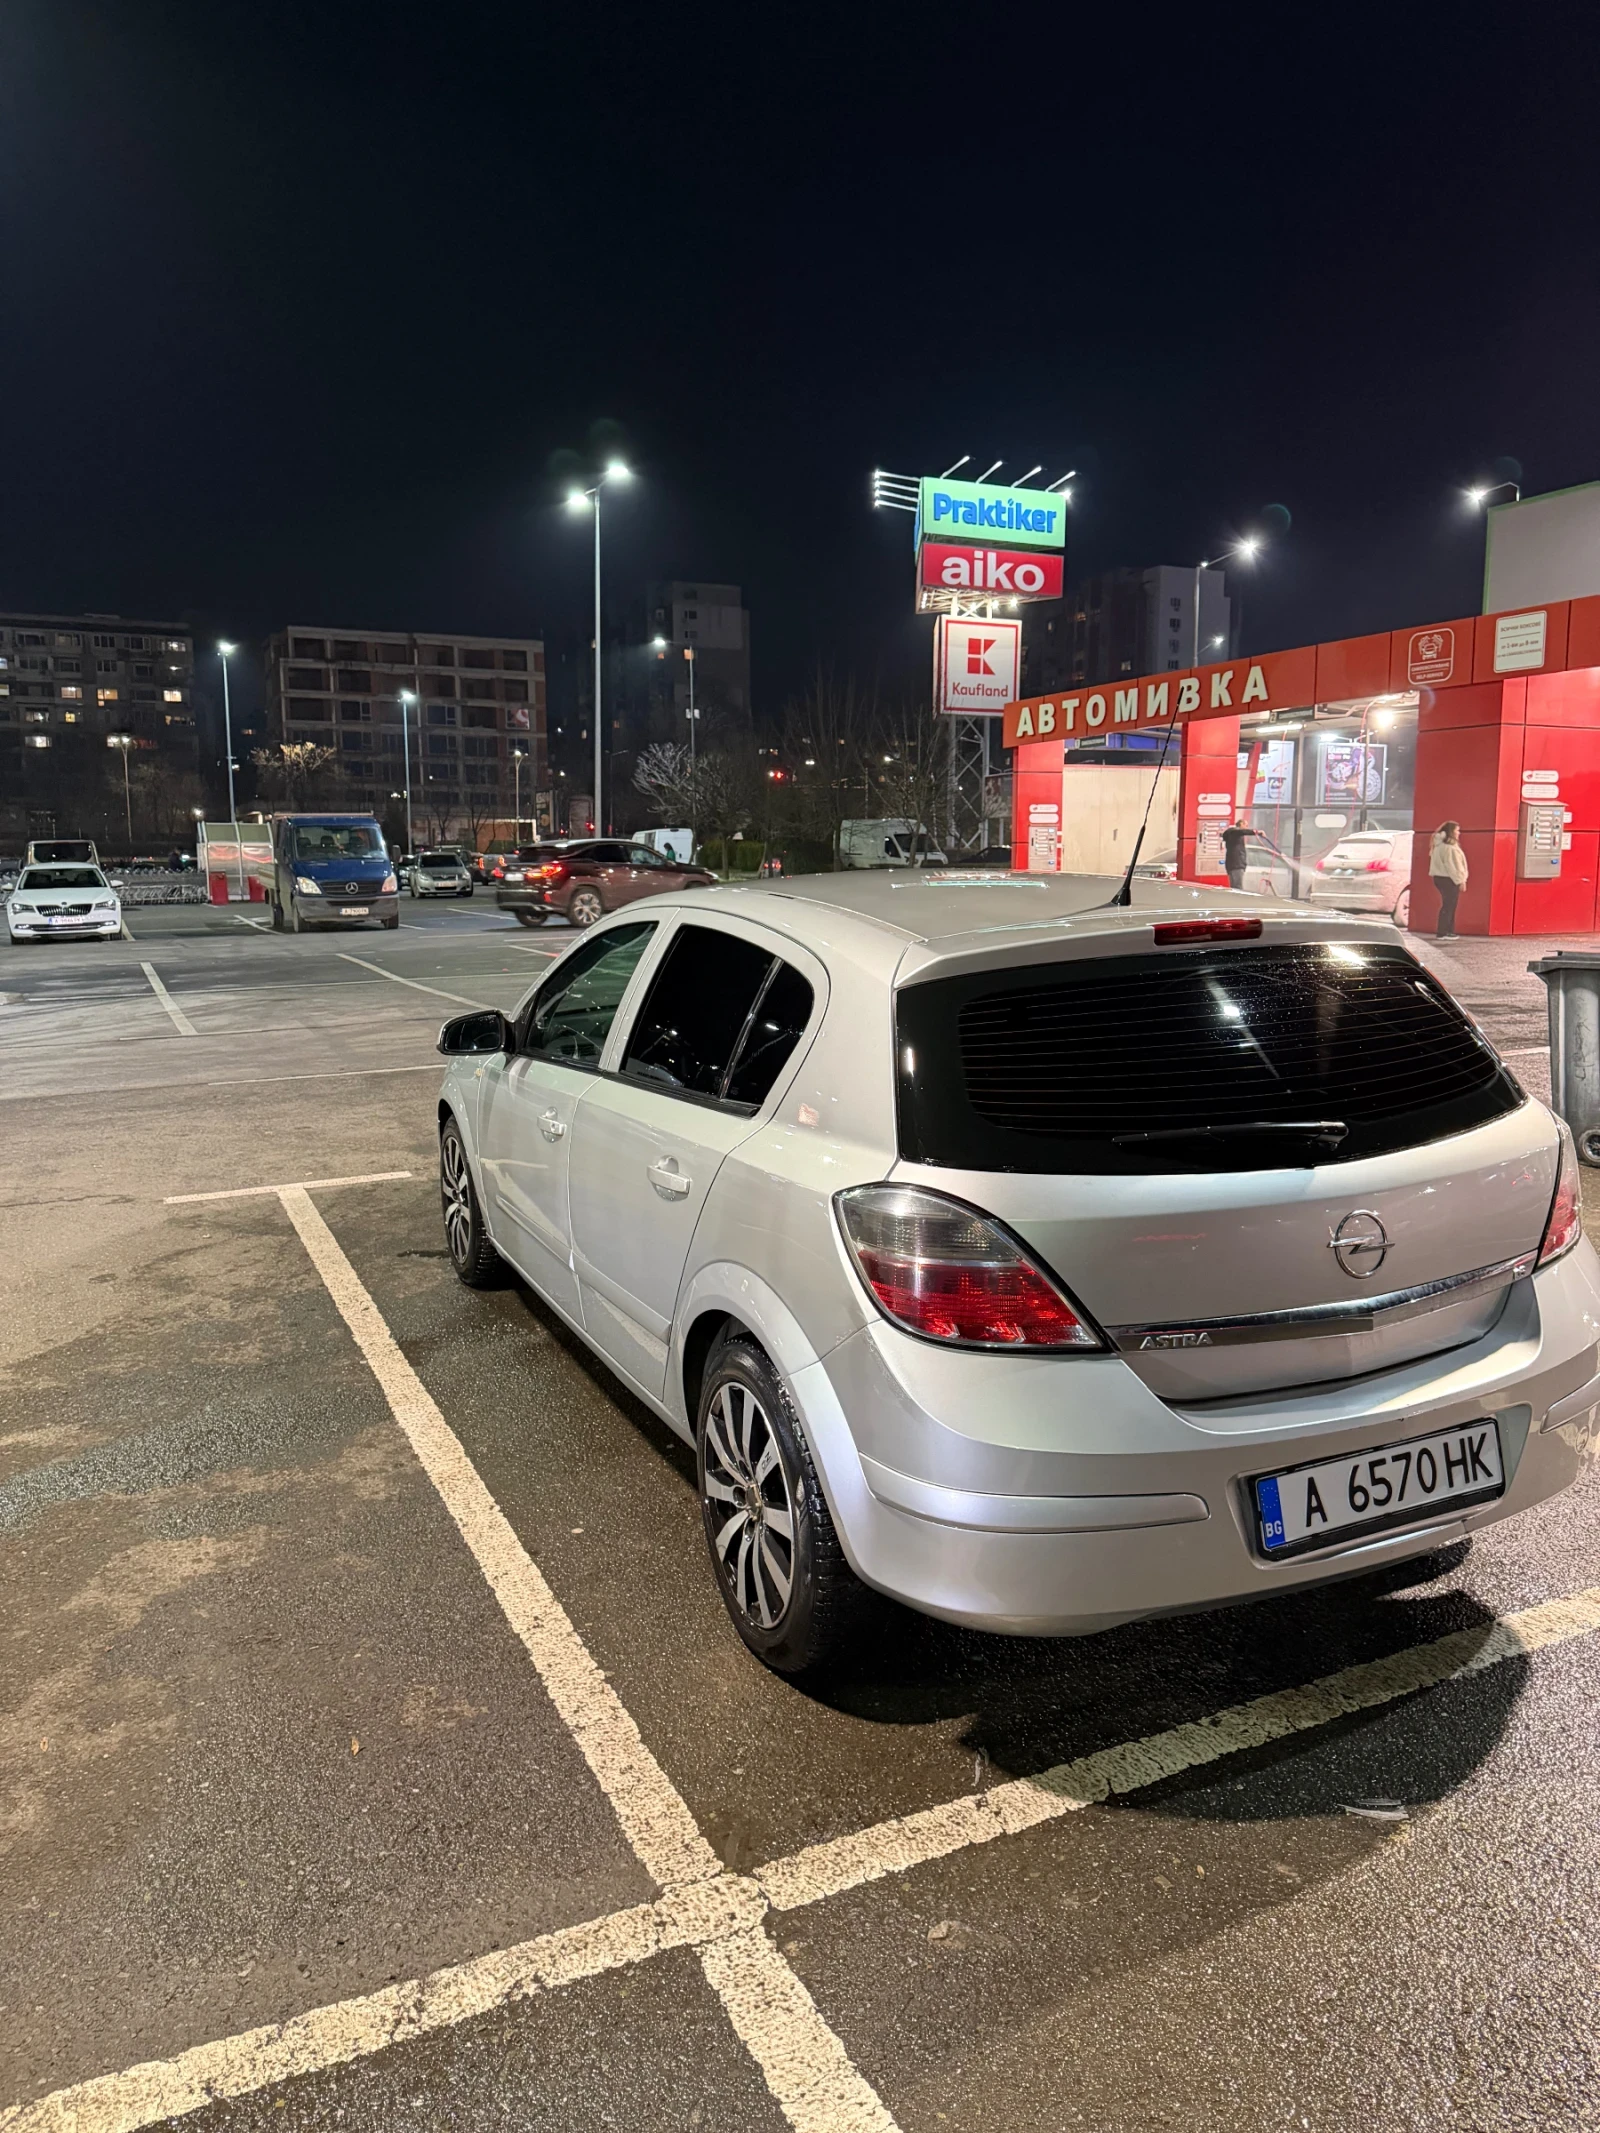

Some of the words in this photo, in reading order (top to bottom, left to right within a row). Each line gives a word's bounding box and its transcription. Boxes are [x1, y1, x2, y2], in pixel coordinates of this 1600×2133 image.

[933, 492, 1057, 533] Praktiker
[941, 550, 1045, 592] aiko
[952, 681, 1009, 697] Kaufland
[1016, 665, 1269, 737] АВТОМИВКА
[1139, 1332, 1213, 1350] ASTRA
[1305, 1476, 1328, 1528] A
[1349, 1447, 1437, 1513] 6570
[1443, 1432, 1494, 1489] HK
[1265, 1520, 1283, 1538] BG
